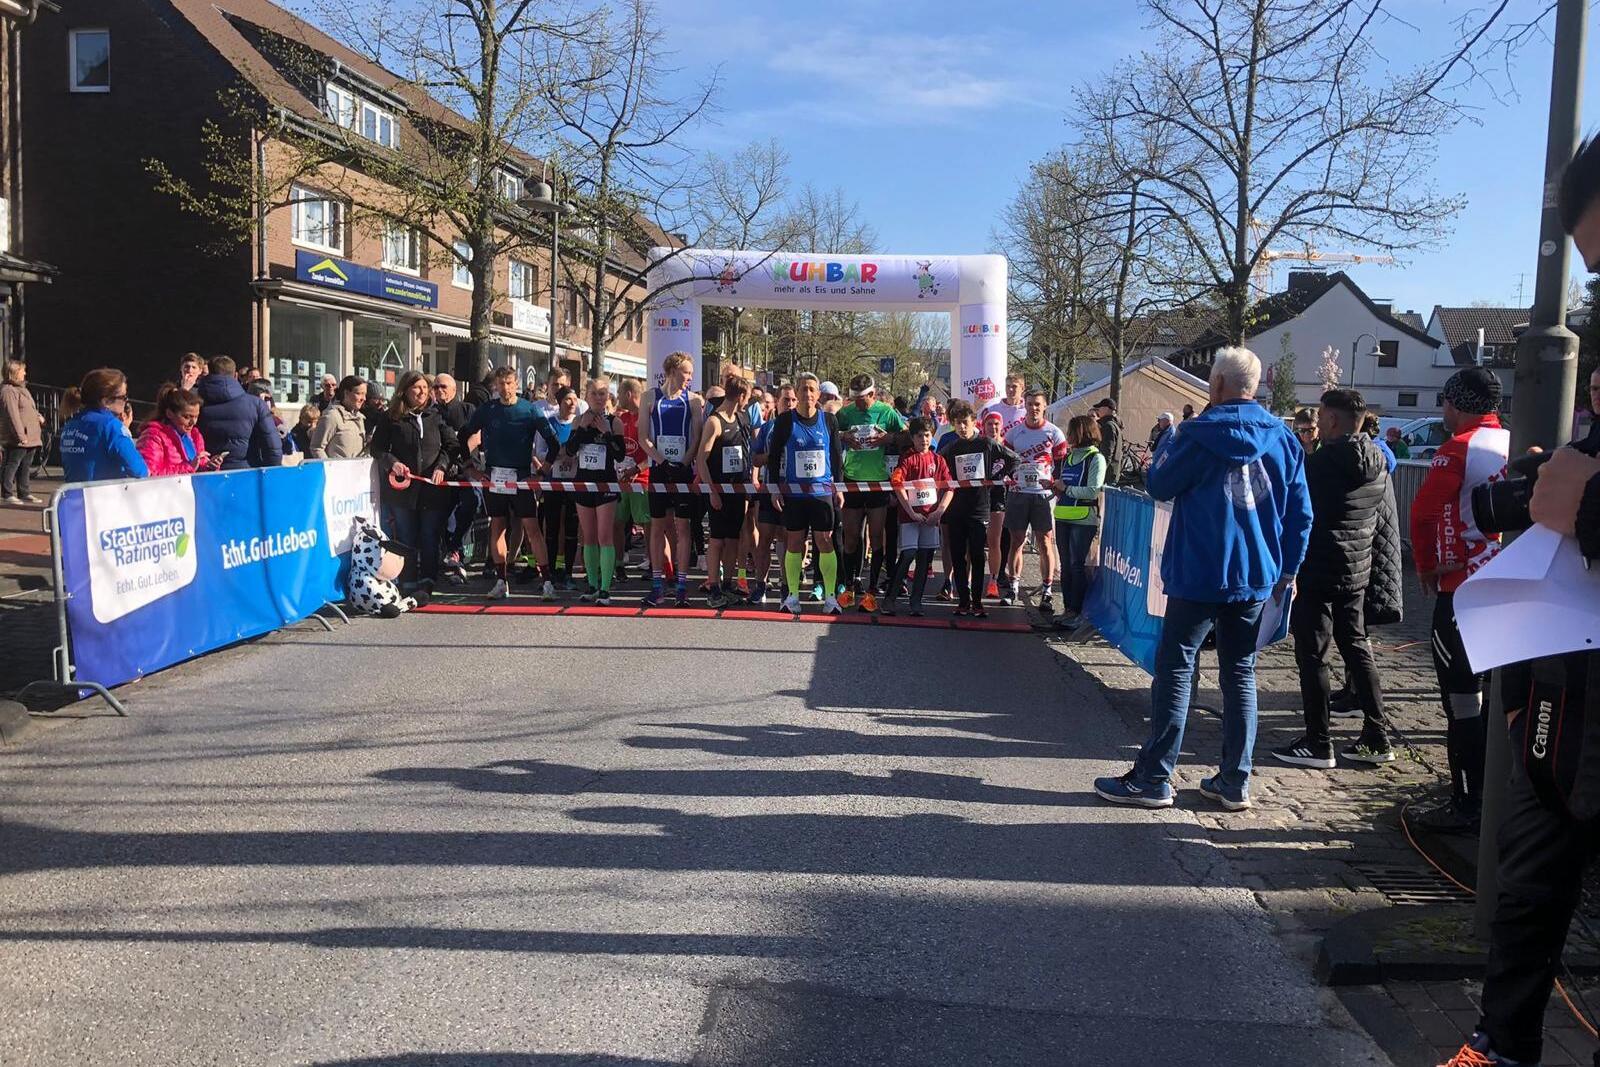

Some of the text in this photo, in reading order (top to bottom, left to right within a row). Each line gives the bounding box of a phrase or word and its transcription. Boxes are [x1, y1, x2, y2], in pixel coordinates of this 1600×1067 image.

[774, 262, 878, 284] KUHBAR
[800, 286, 811, 294] als
[815, 286, 826, 294] Eis
[851, 287, 875, 295] Sahne
[584, 456, 598, 464] 575
[803, 463, 817, 471] 561
[963, 465, 977, 474] 550
[102, 519, 184, 549] Stadtwerke
[114, 540, 176, 567] Ratingen
[116, 578, 137, 595] Echt.
[1532, 700, 1552, 759] Canon
